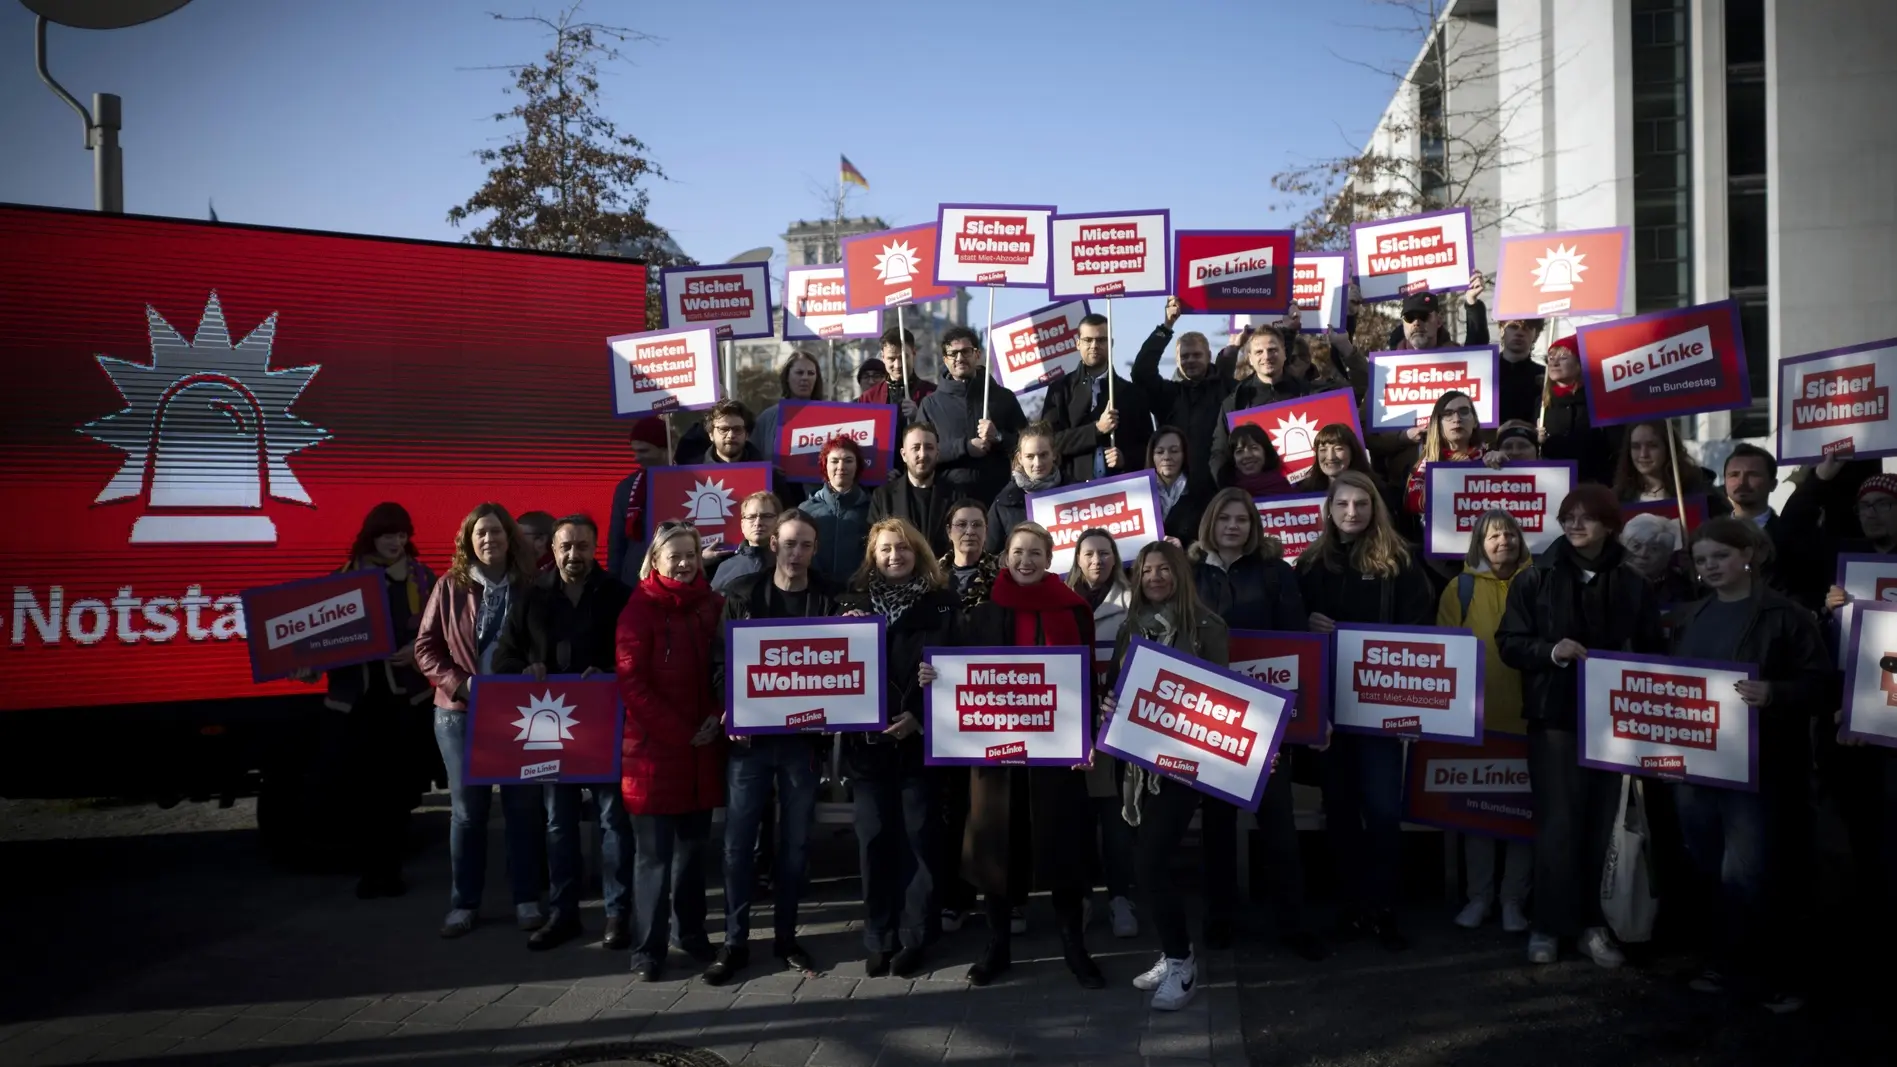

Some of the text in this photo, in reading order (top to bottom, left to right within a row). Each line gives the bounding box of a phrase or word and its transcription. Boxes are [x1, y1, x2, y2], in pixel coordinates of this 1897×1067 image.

[966, 220, 1024, 235] Sicher
[1082, 227, 1135, 241] Mieten
[959, 237, 1031, 253] Wohnen
[1073, 241, 1144, 257] Notstand
[1379, 234, 1441, 254] Sicher
[960, 254, 1028, 263] statt Miet-Abzocke!
[1076, 256, 1142, 273] stoppen!
[1371, 247, 1454, 272] Wohnen!
[1196, 256, 1267, 281] Die Linke
[688, 279, 742, 294] Sicher
[978, 274, 990, 282] Die
[1232, 286, 1272, 295] Bundestag
[683, 295, 750, 311] Wohnen
[1013, 323, 1066, 349] Sicher
[638, 345, 685, 360] Mieten
[632, 356, 693, 375] Notstand
[1612, 342, 1704, 382] Die Linke
[635, 371, 693, 389] stoppen!
[1398, 367, 1465, 384] Sicher
[1663, 377, 1717, 392] Bundestag
[1806, 375, 1872, 399] Sicher
[1796, 395, 1885, 424] Wohnen!
[798, 433, 823, 448] Die
[1467, 479, 1533, 493] Mieten
[1457, 496, 1543, 511] Notstand
[1059, 500, 1124, 525] Sicher
[275, 602, 357, 641] Die Linke
[322, 632, 368, 647] Bundestag
[764, 646, 845, 666] Sicher
[1366, 646, 1441, 668] Sicher
[751, 669, 860, 692] Wohnen!
[970, 668, 1041, 685] Mieten
[1358, 669, 1451, 692] Wohnen
[1626, 676, 1703, 699] Mieten
[959, 689, 1053, 706] Notstand
[1156, 680, 1242, 725] Sicher
[1383, 693, 1448, 706] Miet-Abzocke!
[788, 712, 822, 725] Die Linke
[1614, 696, 1716, 724] Notstand
[962, 710, 1051, 730] stoppen!
[1138, 697, 1250, 757] Wohnen!
[1397, 718, 1418, 727] Linke
[1616, 718, 1712, 744] stoppen!
[988, 744, 1023, 757] Die Linke
[523, 763, 557, 776] Die Linke
[1158, 757, 1195, 772] Die Linke
[1644, 758, 1681, 767] Die Linke
[1434, 763, 1529, 785] Die Linke
[1480, 801, 1533, 819] Bundestag
